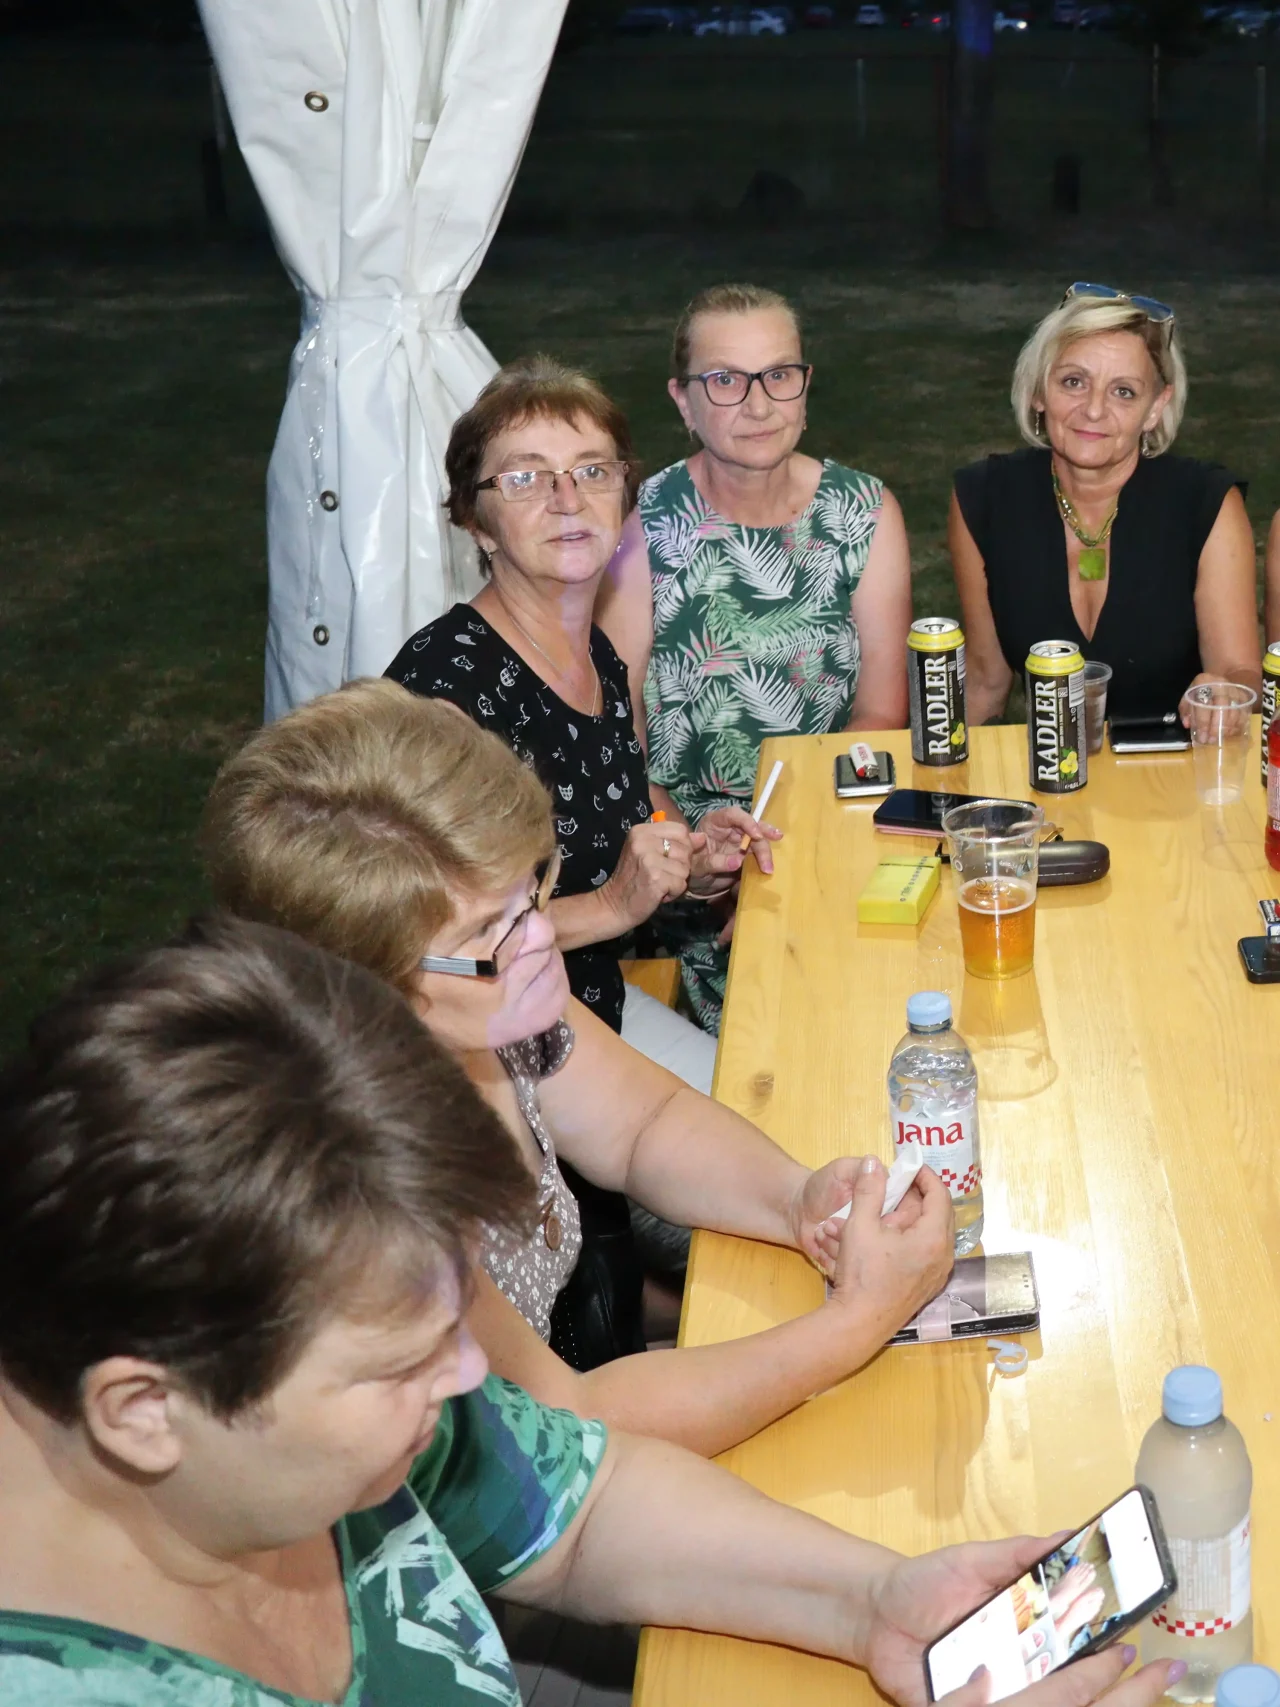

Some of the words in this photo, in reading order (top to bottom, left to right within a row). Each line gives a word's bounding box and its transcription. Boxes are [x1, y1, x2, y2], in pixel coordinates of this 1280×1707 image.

[924, 655, 951, 756] RADLER
[1034, 680, 1060, 783] RADLER
[896, 1121, 964, 1146] Jana
